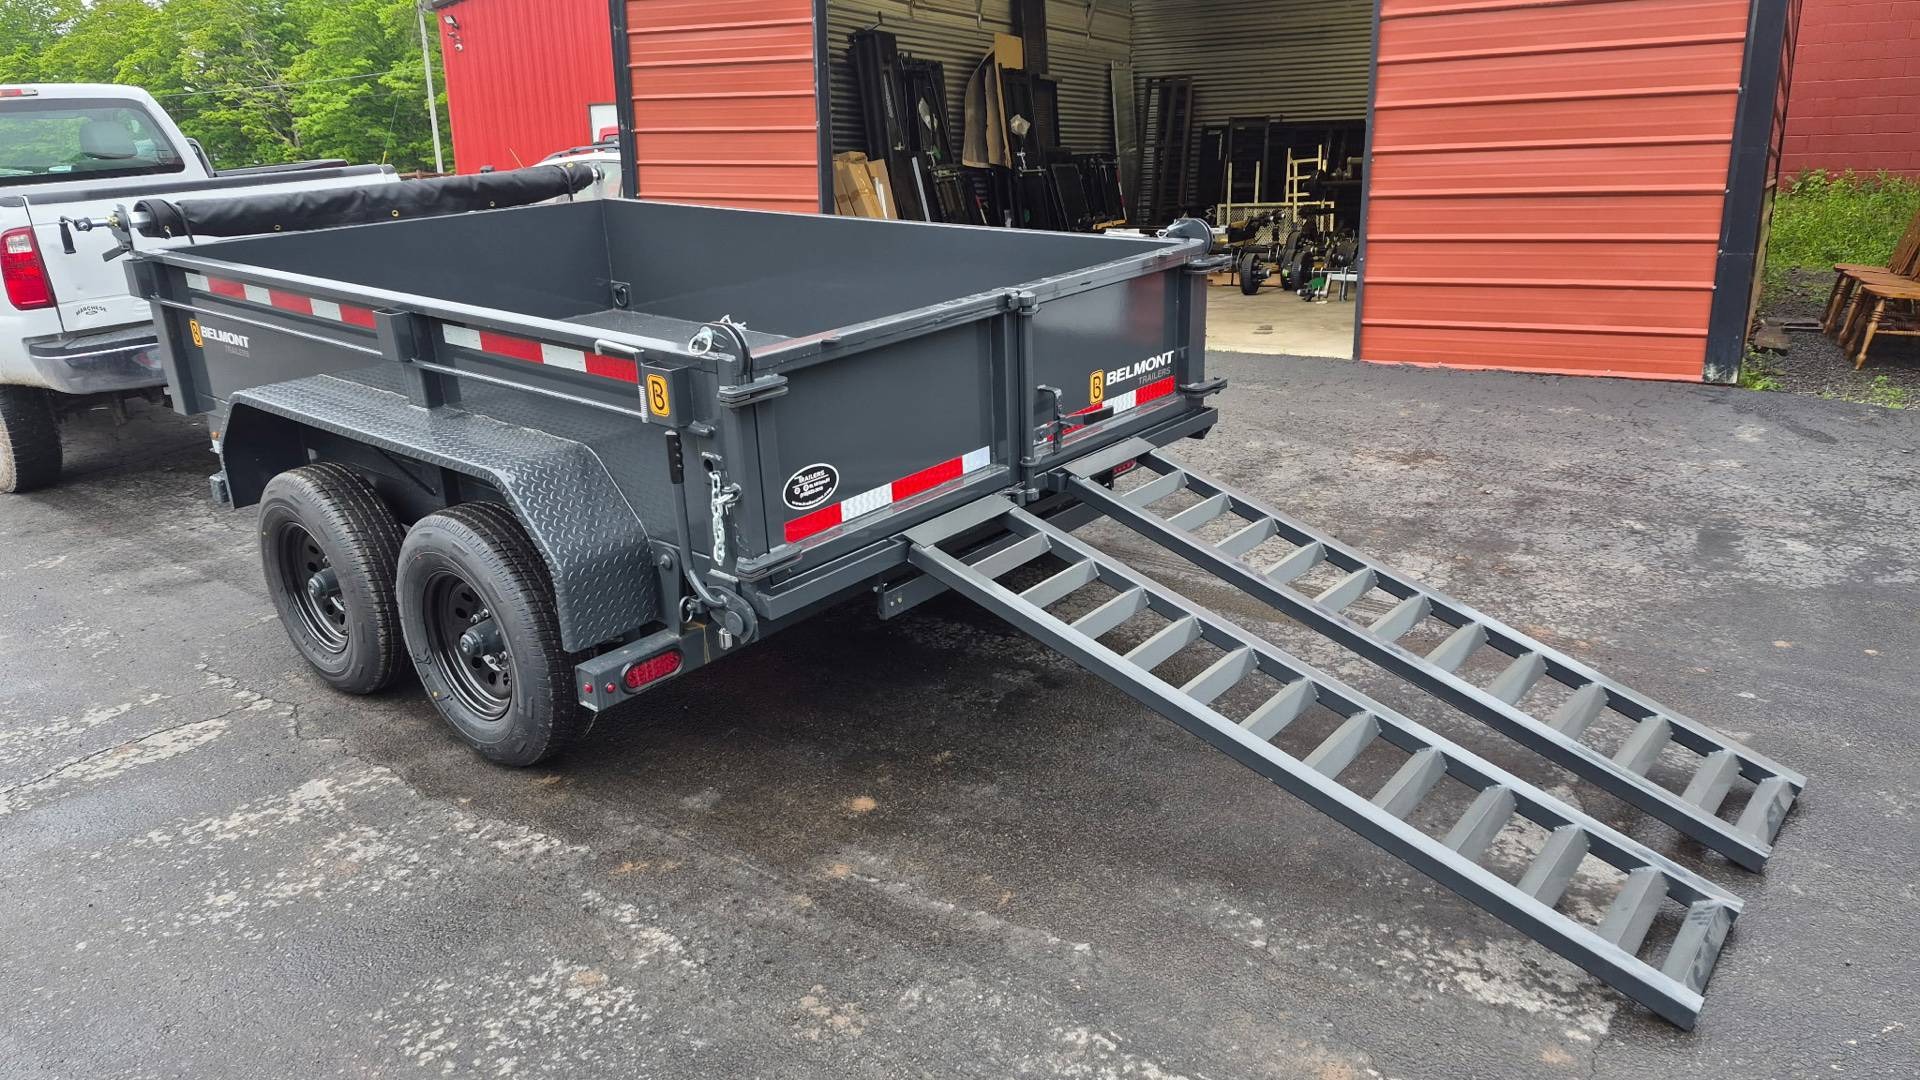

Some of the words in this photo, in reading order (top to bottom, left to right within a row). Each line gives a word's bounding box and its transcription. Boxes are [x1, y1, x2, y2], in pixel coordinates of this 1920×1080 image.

[200, 326, 249, 348] BELMONT
[1106, 350, 1175, 386] BELMONT
[1139, 367, 1171, 385] TRAILERS
[650, 378, 667, 412] B
